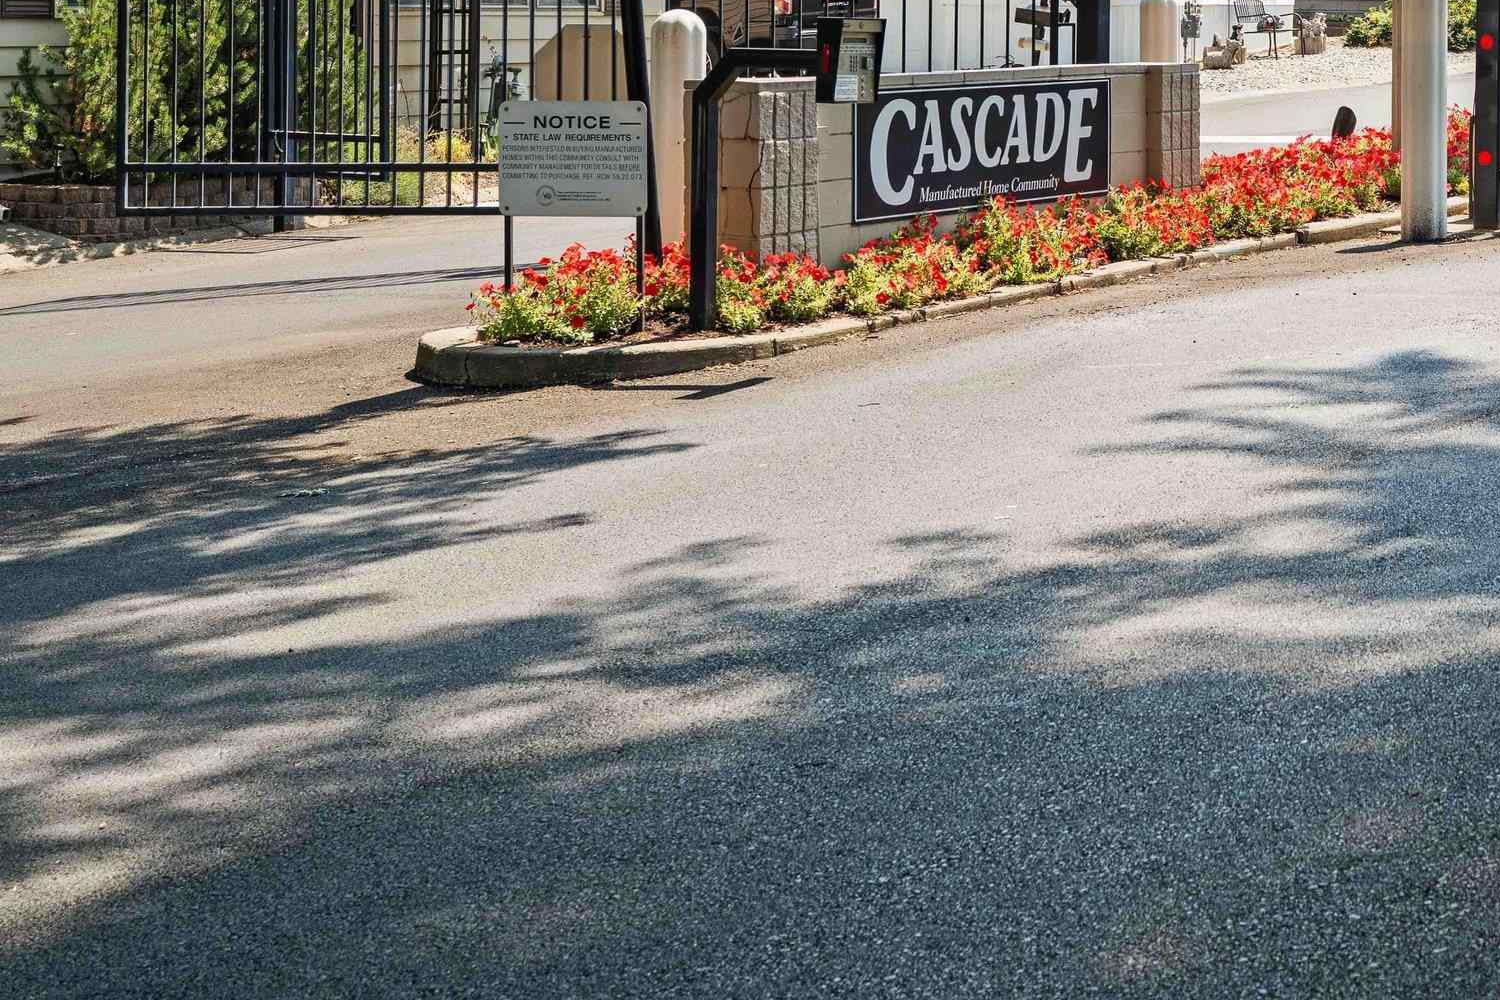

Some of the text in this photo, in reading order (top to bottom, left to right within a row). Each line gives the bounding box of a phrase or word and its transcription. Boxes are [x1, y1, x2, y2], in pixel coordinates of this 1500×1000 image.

[533, 115, 611, 129] NOTICE
[512, 133, 632, 142] STATE LAW REQUIREMENTS
[869, 87, 1099, 206] CASCADE
[919, 173, 1060, 204] Manufactured Home Community
